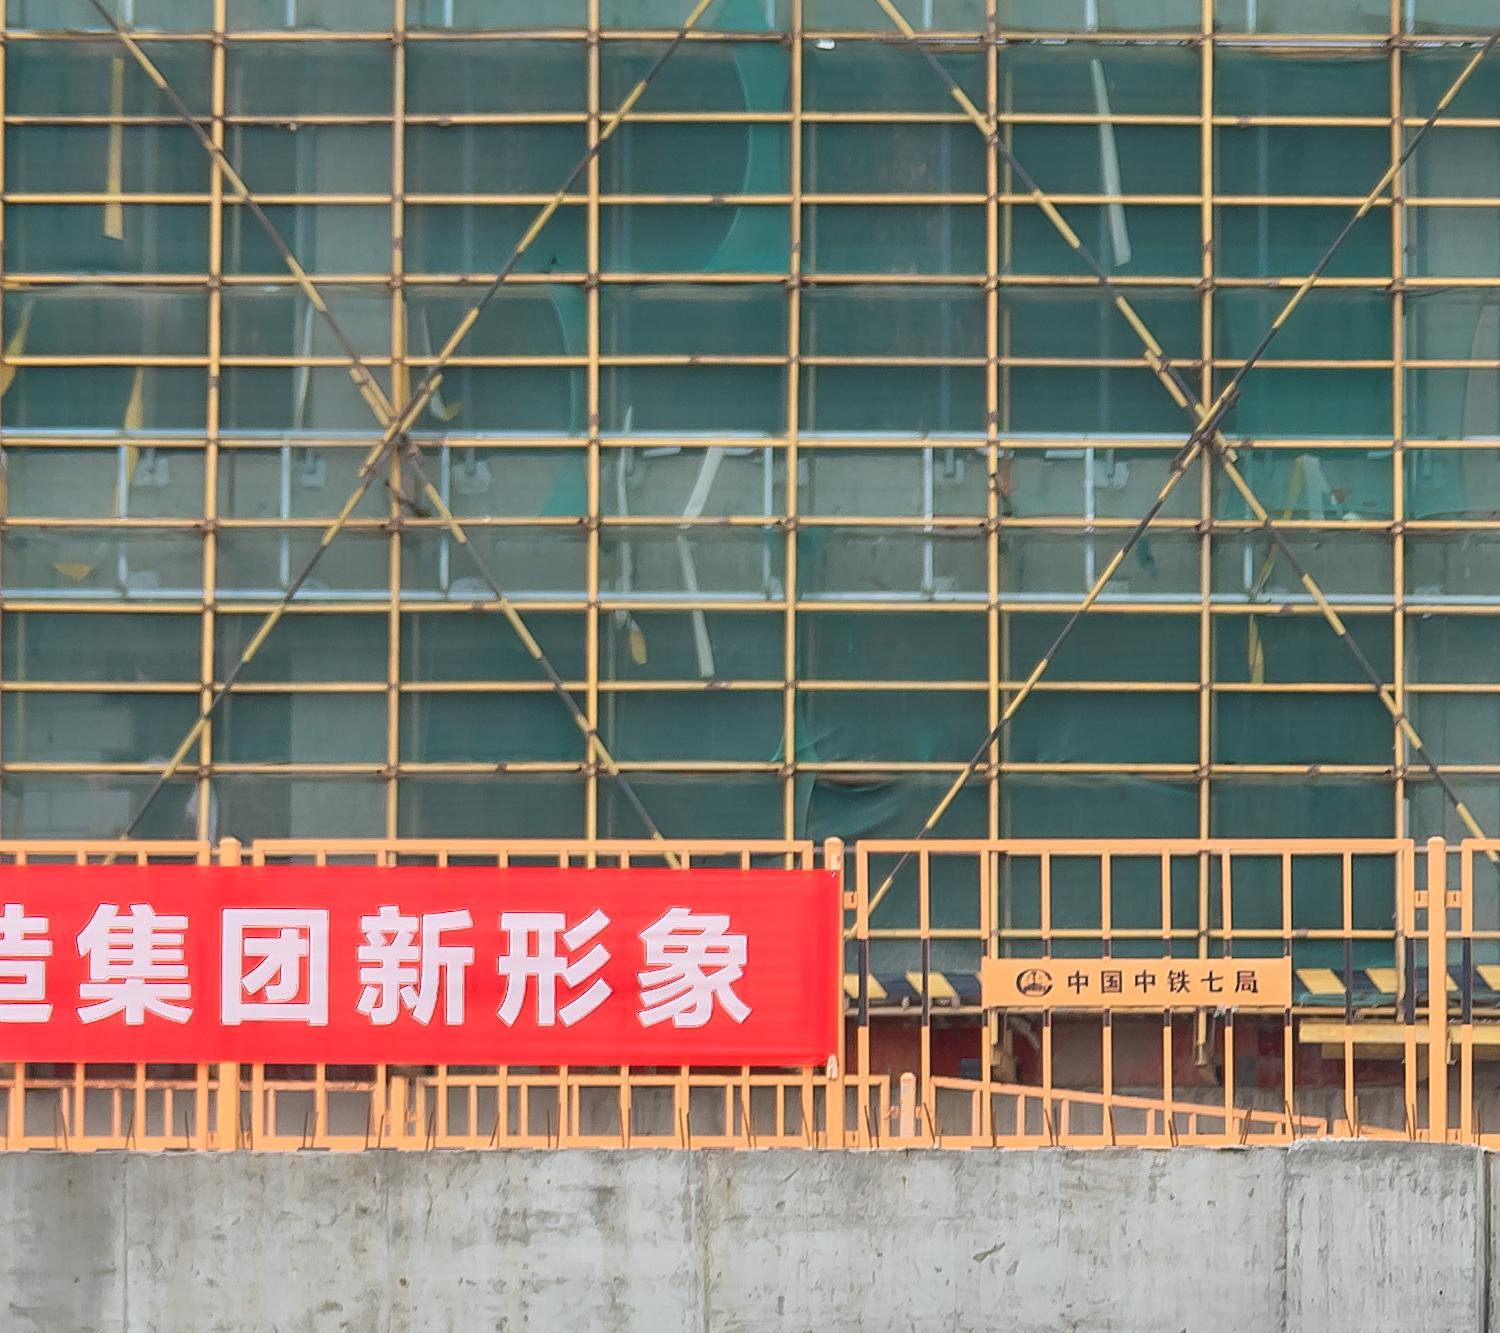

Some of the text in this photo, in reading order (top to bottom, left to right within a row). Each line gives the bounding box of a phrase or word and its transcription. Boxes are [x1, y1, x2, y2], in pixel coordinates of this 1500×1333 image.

[1066, 970, 1258, 996] 中国中铁七局
